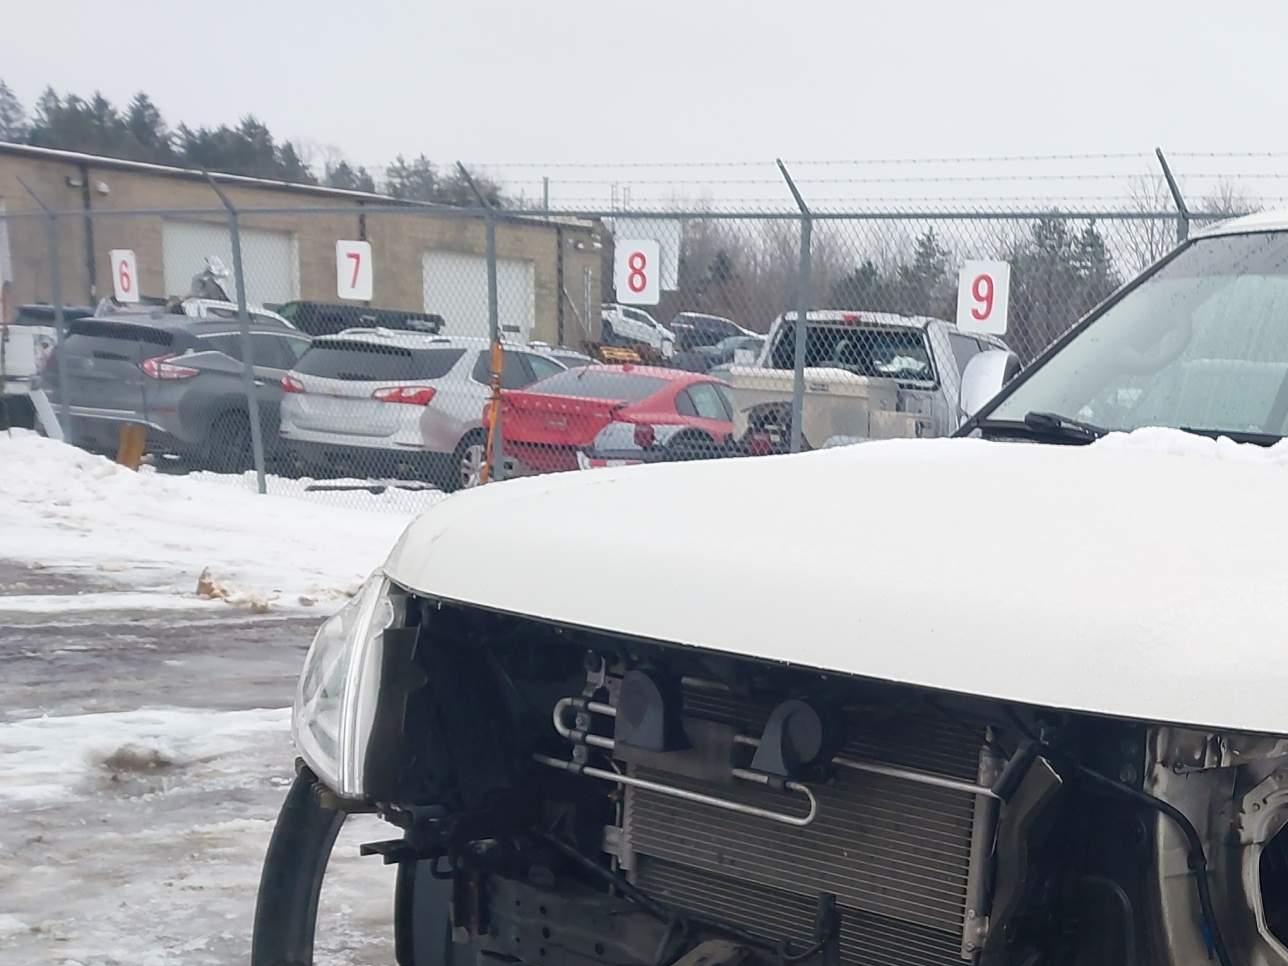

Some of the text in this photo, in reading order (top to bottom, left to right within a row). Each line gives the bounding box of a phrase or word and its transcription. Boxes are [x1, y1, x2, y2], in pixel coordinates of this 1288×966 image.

[119, 260, 131, 293] 6
[346, 253, 361, 289] 7
[628, 252, 647, 293] 8
[971, 274, 994, 320] 9
